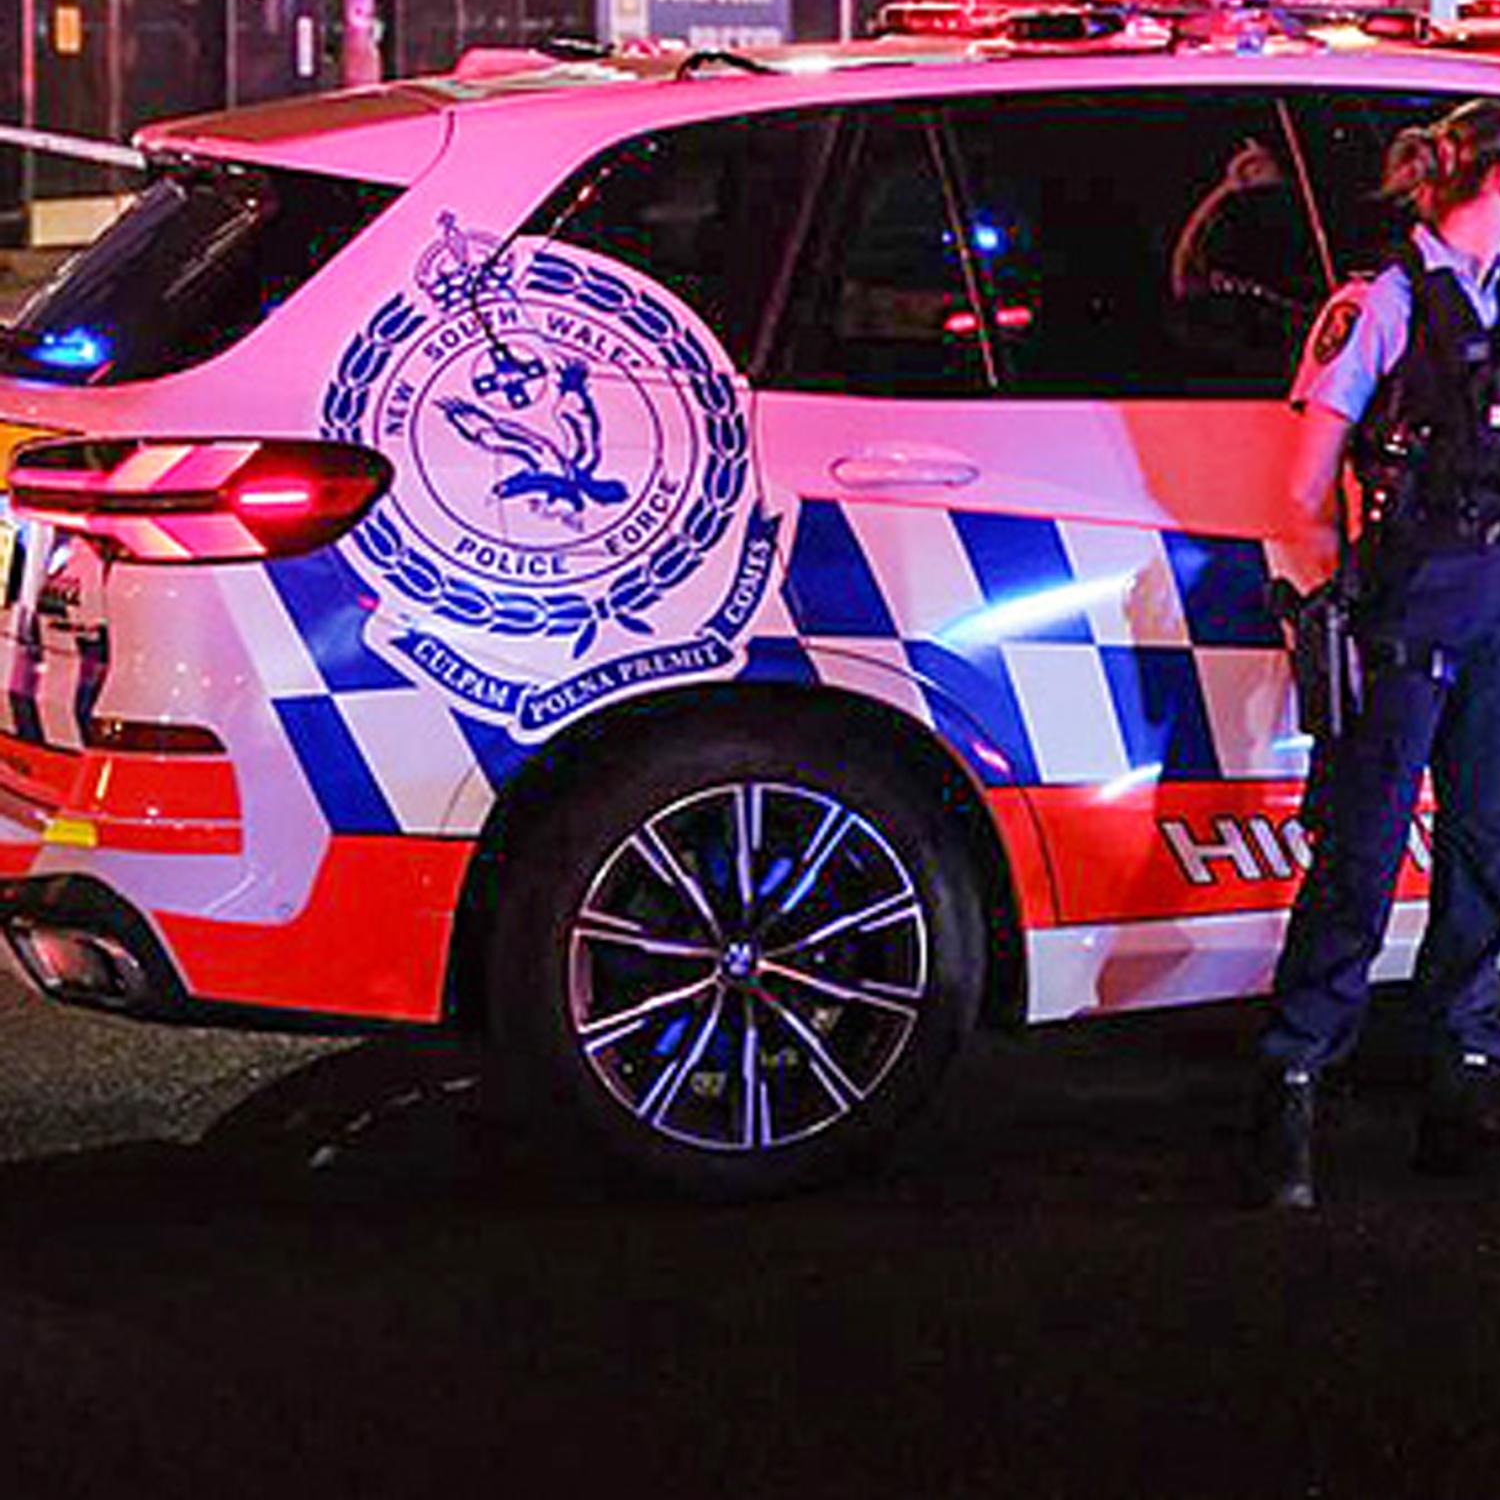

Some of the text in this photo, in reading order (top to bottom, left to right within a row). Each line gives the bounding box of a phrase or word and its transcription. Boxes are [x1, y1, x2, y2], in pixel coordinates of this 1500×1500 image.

[386, 379, 415, 436] NEW
[454, 478, 681, 575] POLICE FORCE
[412, 638, 511, 708] CULPAM
[529, 670, 614, 721] POENA
